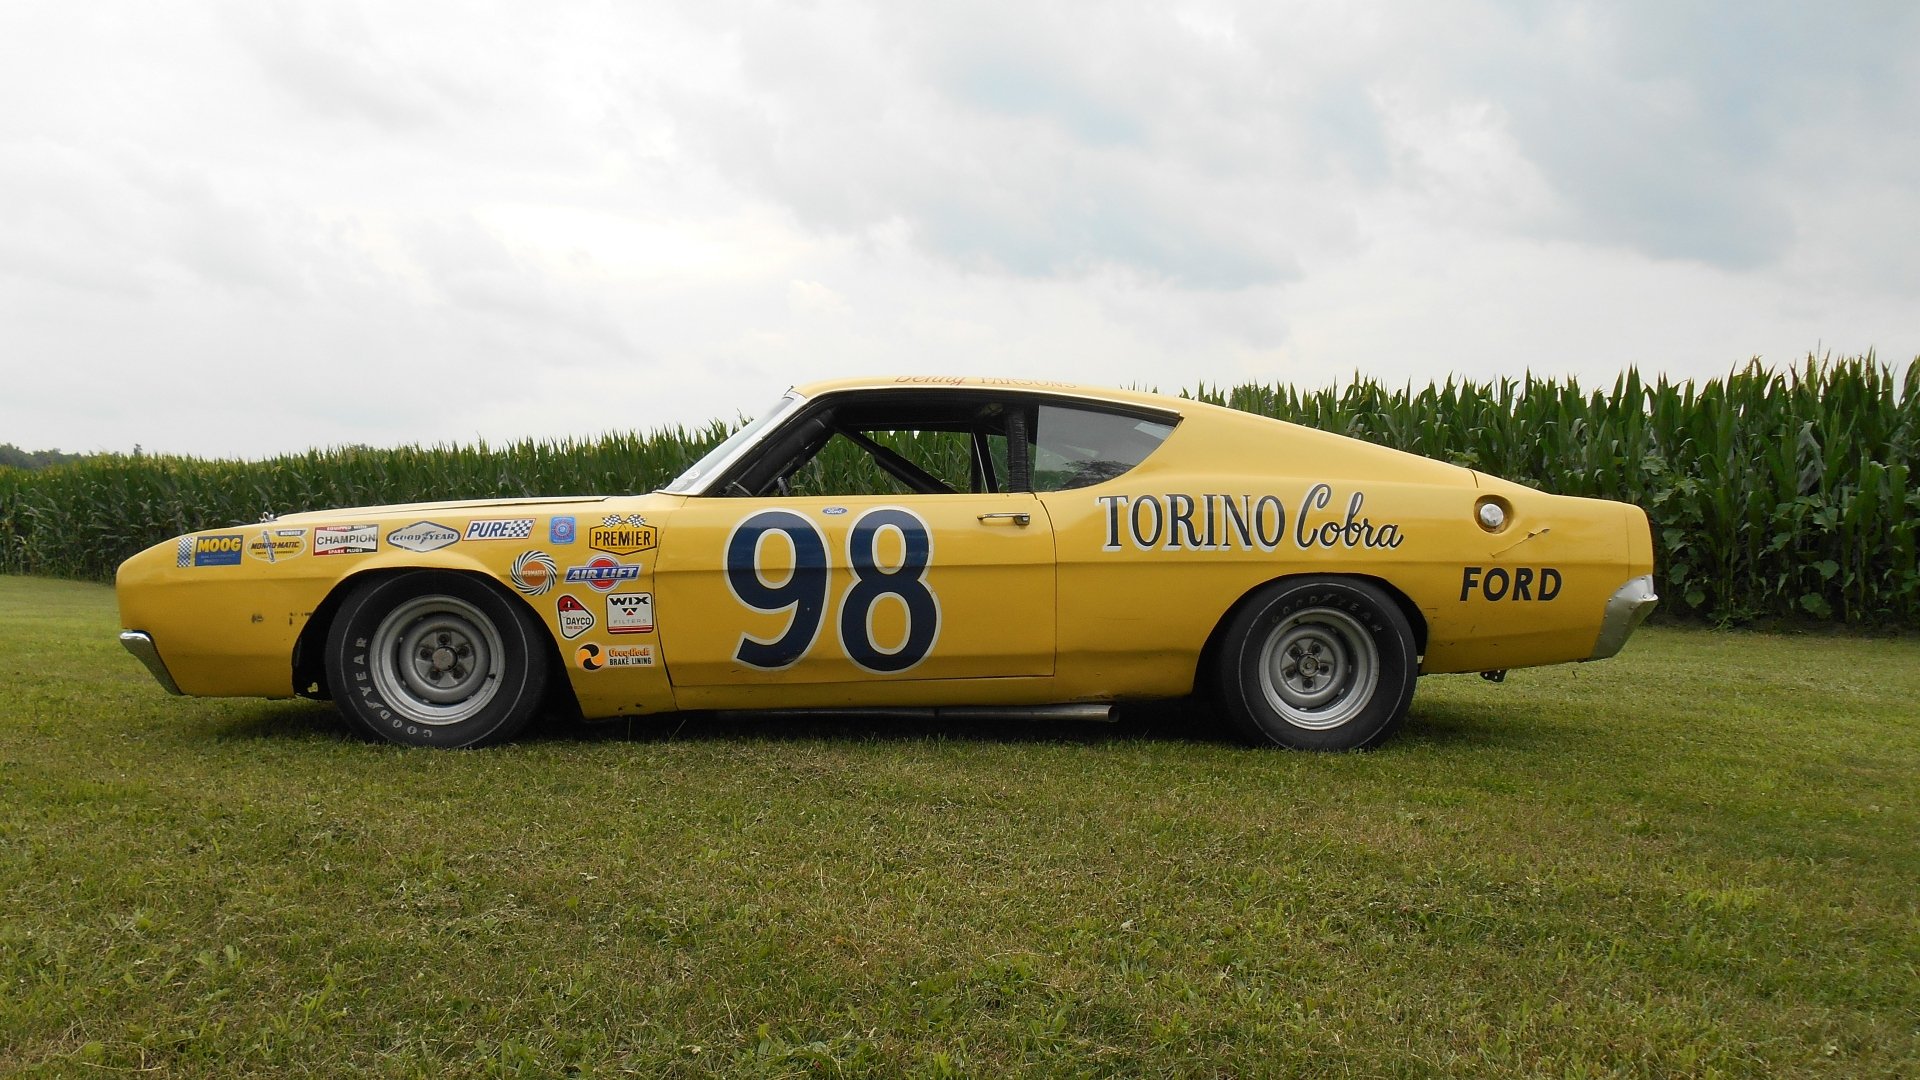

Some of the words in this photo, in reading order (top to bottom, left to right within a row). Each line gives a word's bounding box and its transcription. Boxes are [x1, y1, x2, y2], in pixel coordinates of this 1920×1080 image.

[1098, 493, 1286, 553] TORINO
[1295, 483, 1404, 551] Cobra
[466, 519, 509, 539] PURE
[197, 537, 242, 553] MOOG
[316, 534, 376, 546] CHAMPION
[594, 530, 651, 547] PREMIER
[569, 568, 598, 580] AIR
[600, 567, 638, 579] LIFT
[722, 505, 942, 676] 98
[1459, 566, 1563, 602] FORD
[609, 596, 650, 606] WIX
[566, 616, 591, 626] DAYCO
[613, 617, 648, 625] FILTERS
[609, 658, 630, 666] BRAKE
[631, 657, 652, 665] LINING
